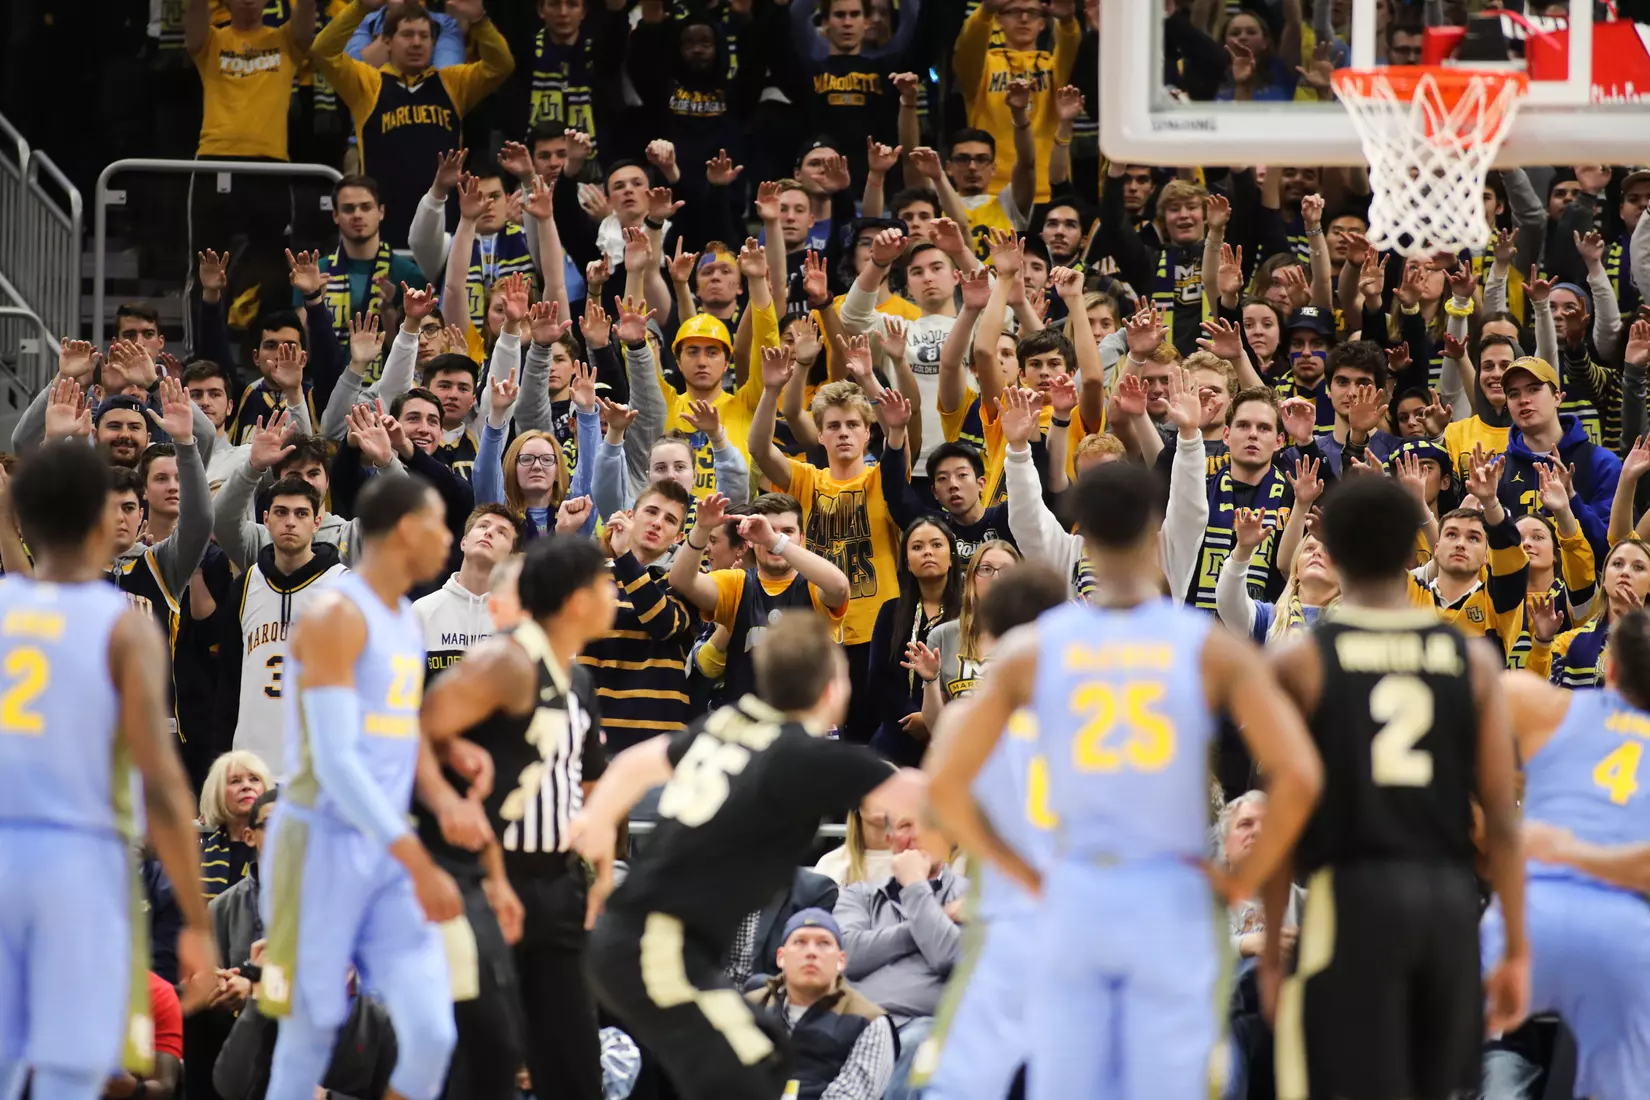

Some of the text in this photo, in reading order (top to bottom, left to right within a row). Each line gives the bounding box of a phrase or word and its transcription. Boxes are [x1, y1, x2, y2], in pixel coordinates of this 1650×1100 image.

[248, 621, 292, 656] MARQU
[428, 655, 465, 670] GOLDE
[441, 633, 493, 647] MARQUE
[0, 645, 50, 734] 2
[1068, 681, 1178, 774] 25
[1369, 672, 1435, 788] 2
[1592, 740, 1643, 807] 4
